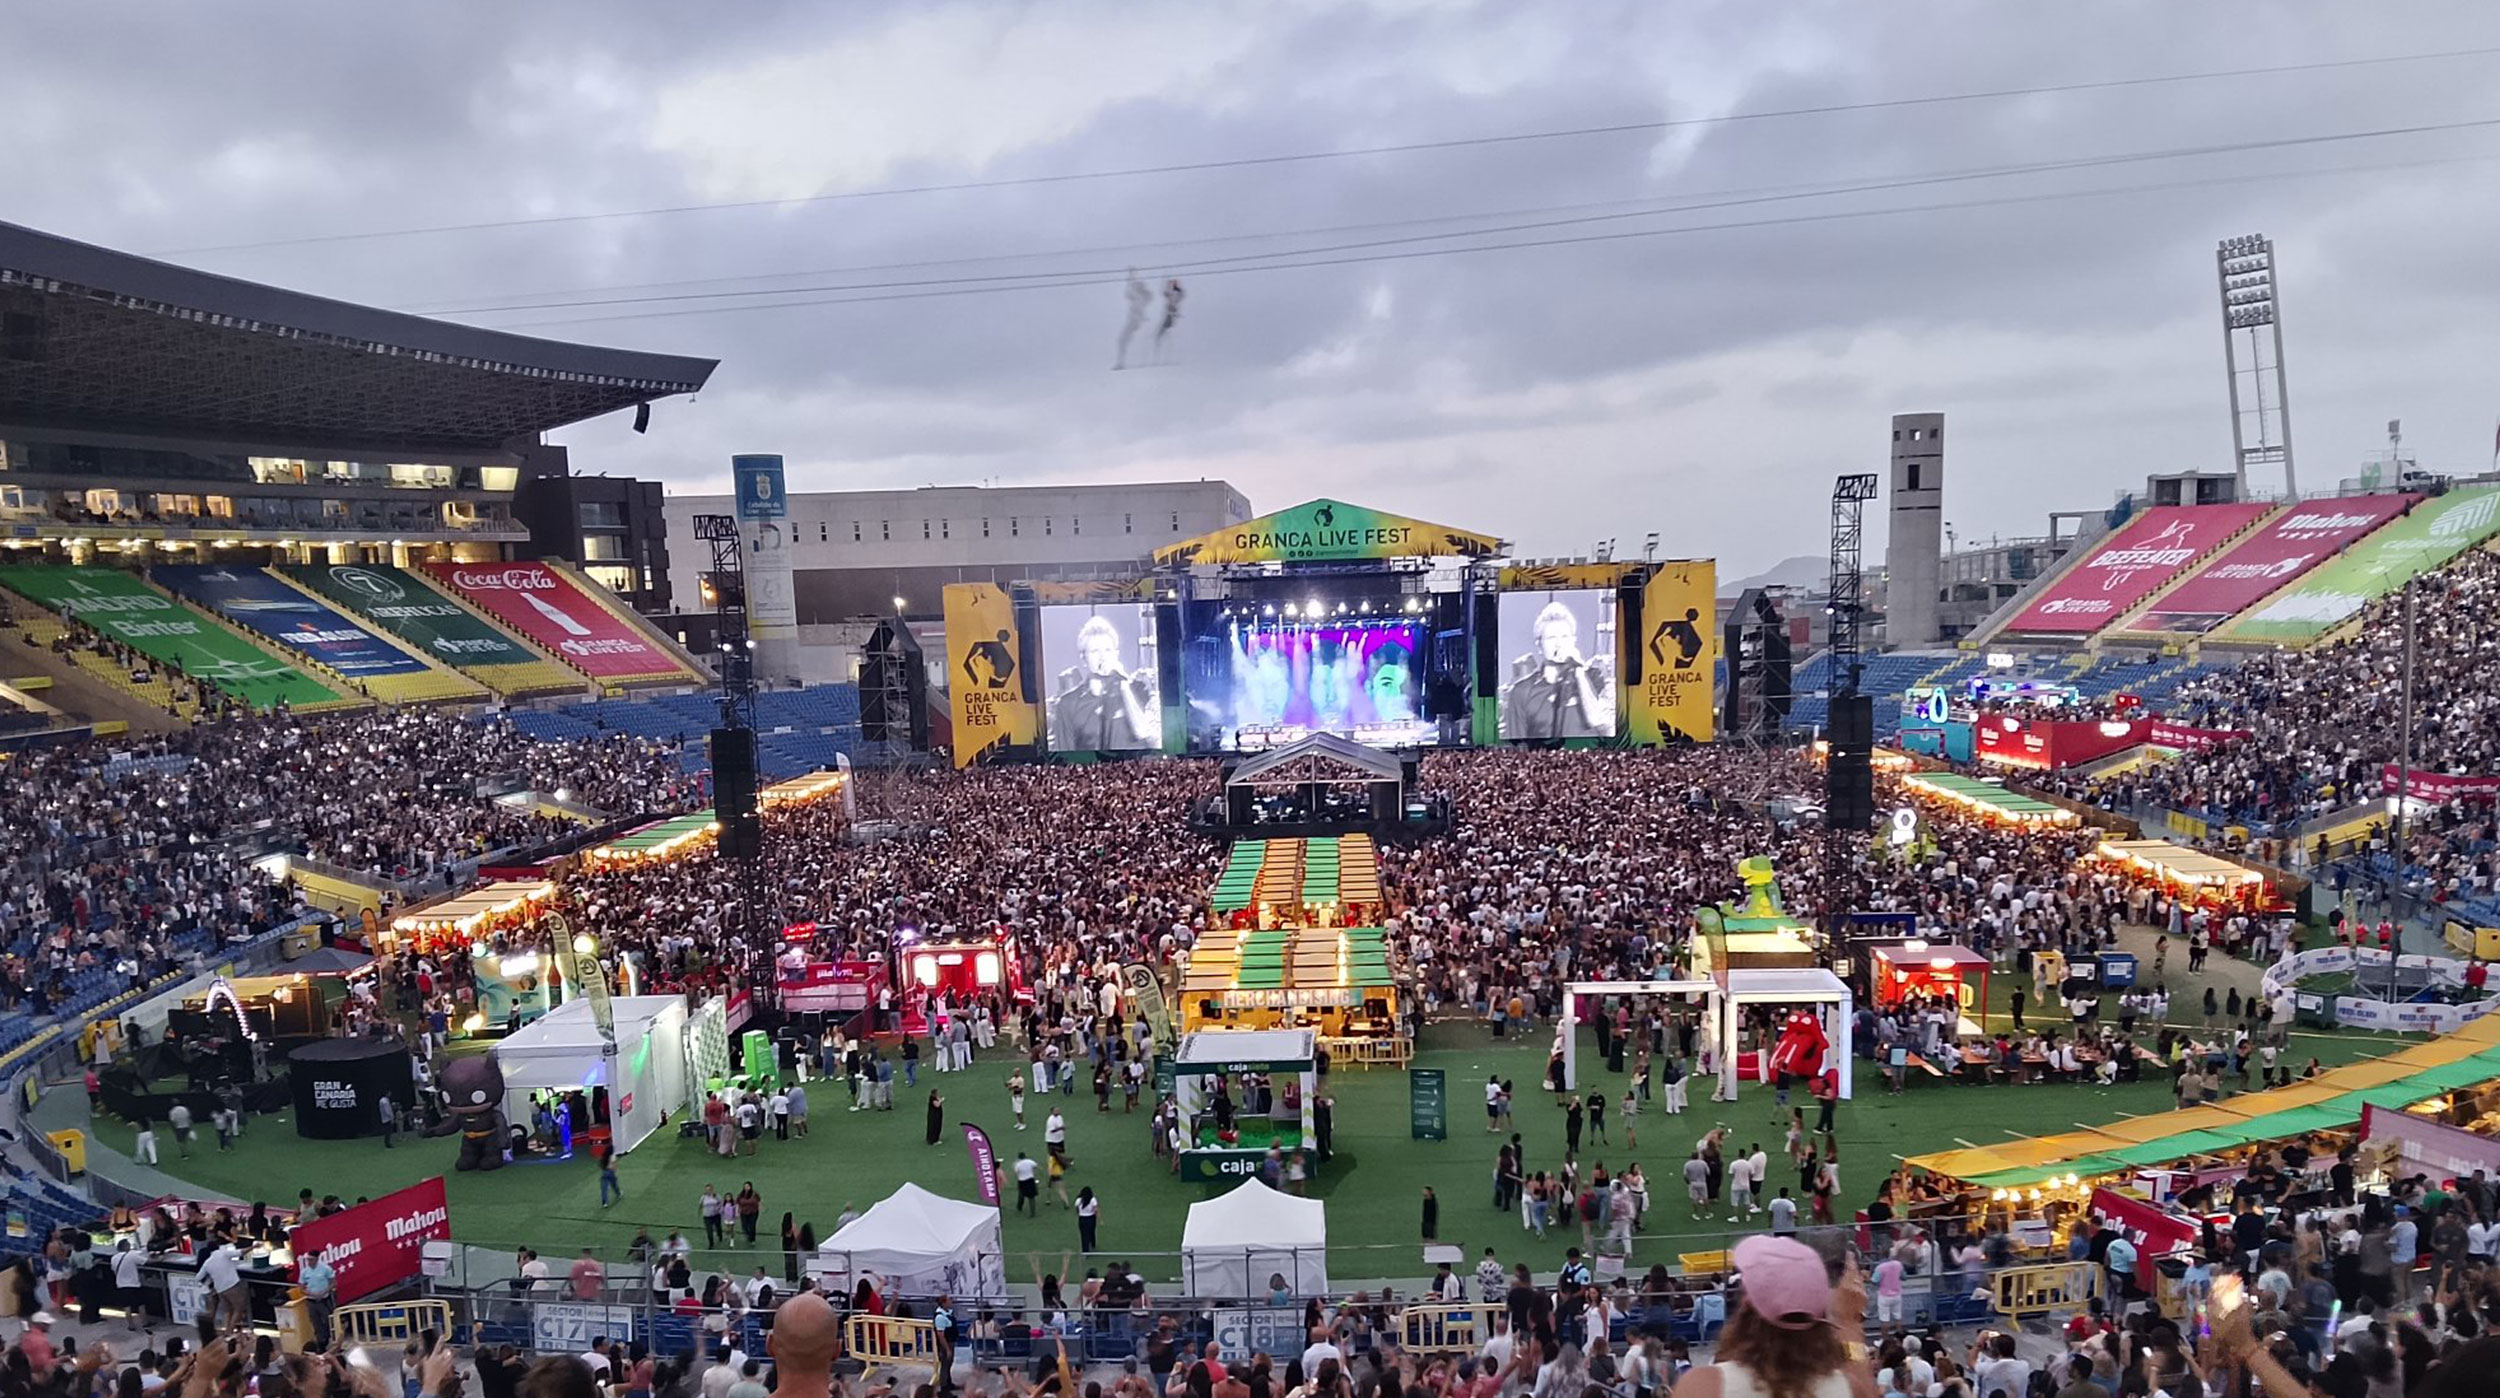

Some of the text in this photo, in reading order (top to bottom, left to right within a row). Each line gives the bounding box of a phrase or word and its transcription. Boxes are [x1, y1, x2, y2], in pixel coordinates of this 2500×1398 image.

[2279, 512, 2378, 530] Mahou
[1235, 527, 1411, 549] GRANCA LIVE FEST
[2087, 549, 2196, 568] BEEFEATER
[453, 569, 557, 590] Coca-Cola
[66, 579, 101, 594] A
[109, 619, 202, 637] Binter
[1649, 672, 1703, 684] GRANCA
[1649, 684, 1678, 695] LIVE
[964, 692, 1018, 704] GRANCA
[1649, 695, 1682, 707] FEST
[966, 703, 993, 715] LIVE
[967, 714, 998, 726] FEST
[1223, 988, 1350, 1006] MERCHANDISING
[313, 1081, 341, 1090] GRAN
[314, 1089, 356, 1100] CANARIA
[329, 1099, 357, 1109] GUSTA
[385, 1206, 447, 1241] Mahou
[547, 1306, 583, 1317] SECTOR
[538, 1317, 583, 1339] C17
[1219, 1326, 1273, 1348] C18
